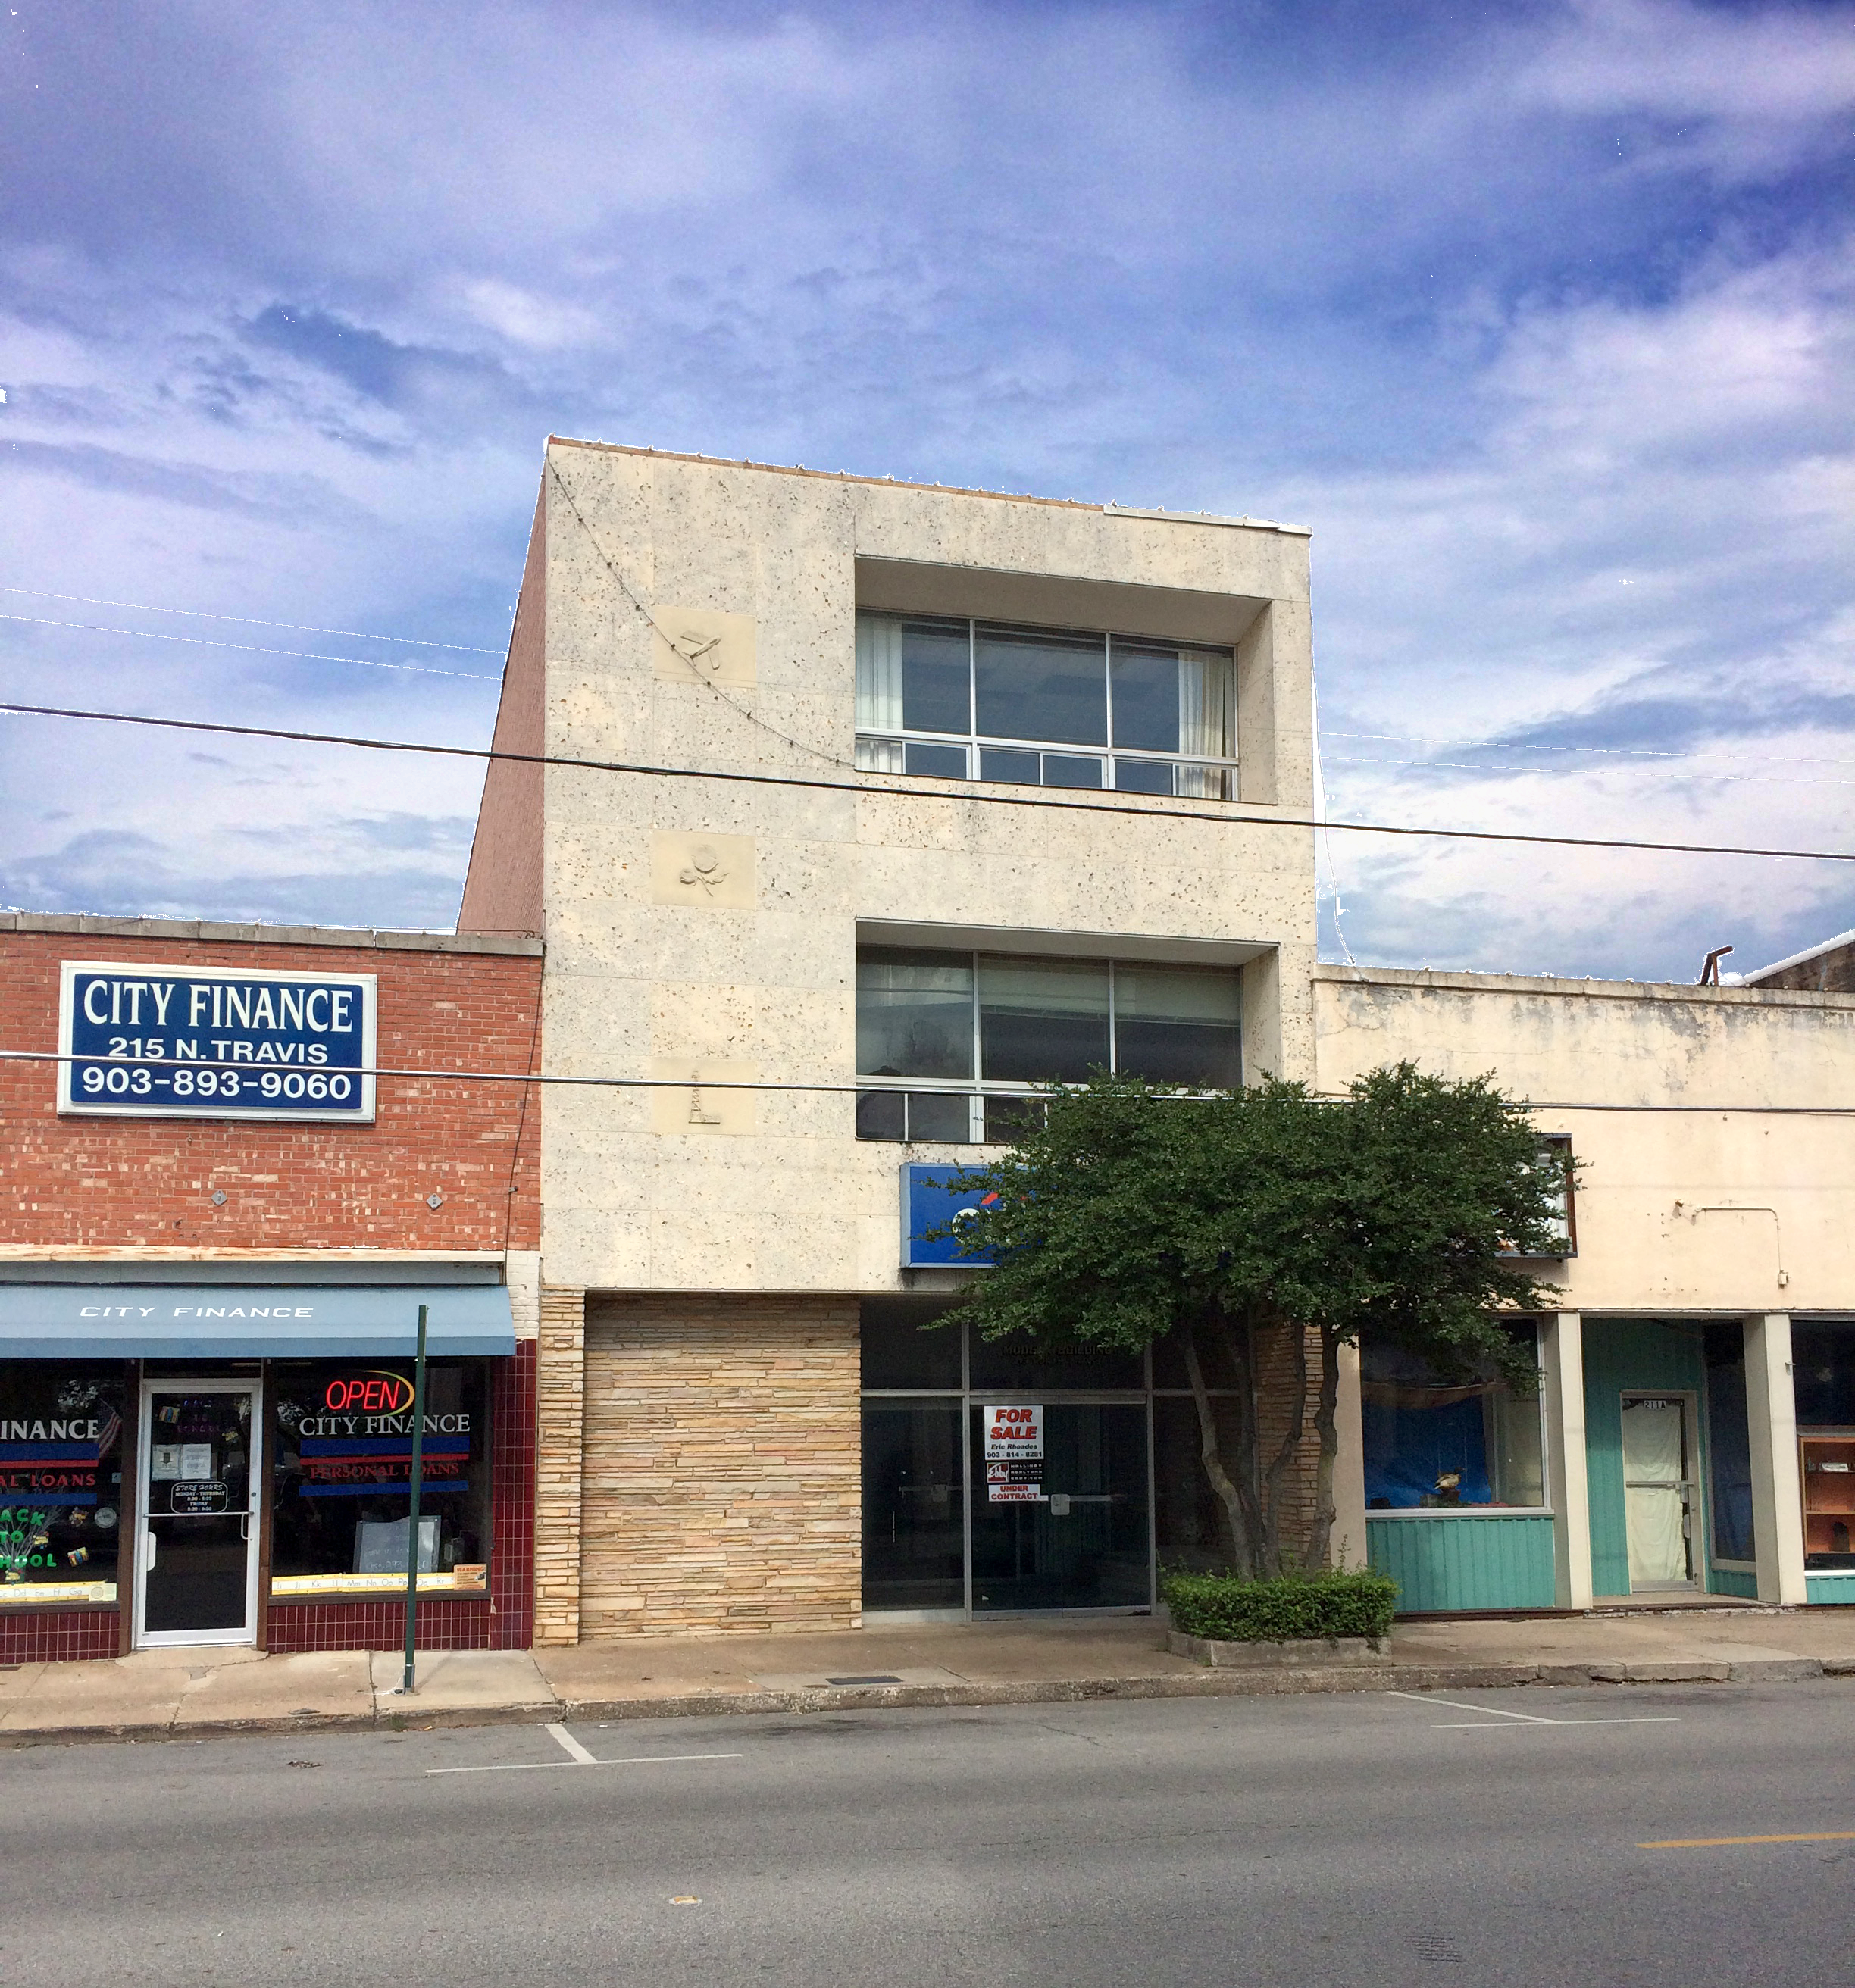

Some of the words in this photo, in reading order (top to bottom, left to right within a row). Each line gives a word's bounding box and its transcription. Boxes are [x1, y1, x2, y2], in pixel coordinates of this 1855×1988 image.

[84, 980, 175, 1026] CITY
[188, 984, 353, 1033] FINANCE
[108, 1037, 165, 1058] 215
[211, 1040, 328, 1064] TRAVIS
[83, 1067, 352, 1099] 903-893-9060
[80, 1307, 156, 1317] CITY
[174, 1307, 314, 1318] FINANCE
[326, 1380, 400, 1410] OPEN
[1644, 1400, 1666, 1409] 211A
[995, 1409, 1032, 1423] FOR
[0, 1419, 99, 1439] INANCE
[299, 1415, 359, 1436] CITY
[990, 1426, 1037, 1440] SALE
[31, 1474, 95, 1486] LOANS
[310, 1464, 398, 1479] PERSONAL
[988, 1463, 1009, 1481] Ebby
[0, 1508, 45, 1526] ACK
[0, 1530, 24, 1543] TO
